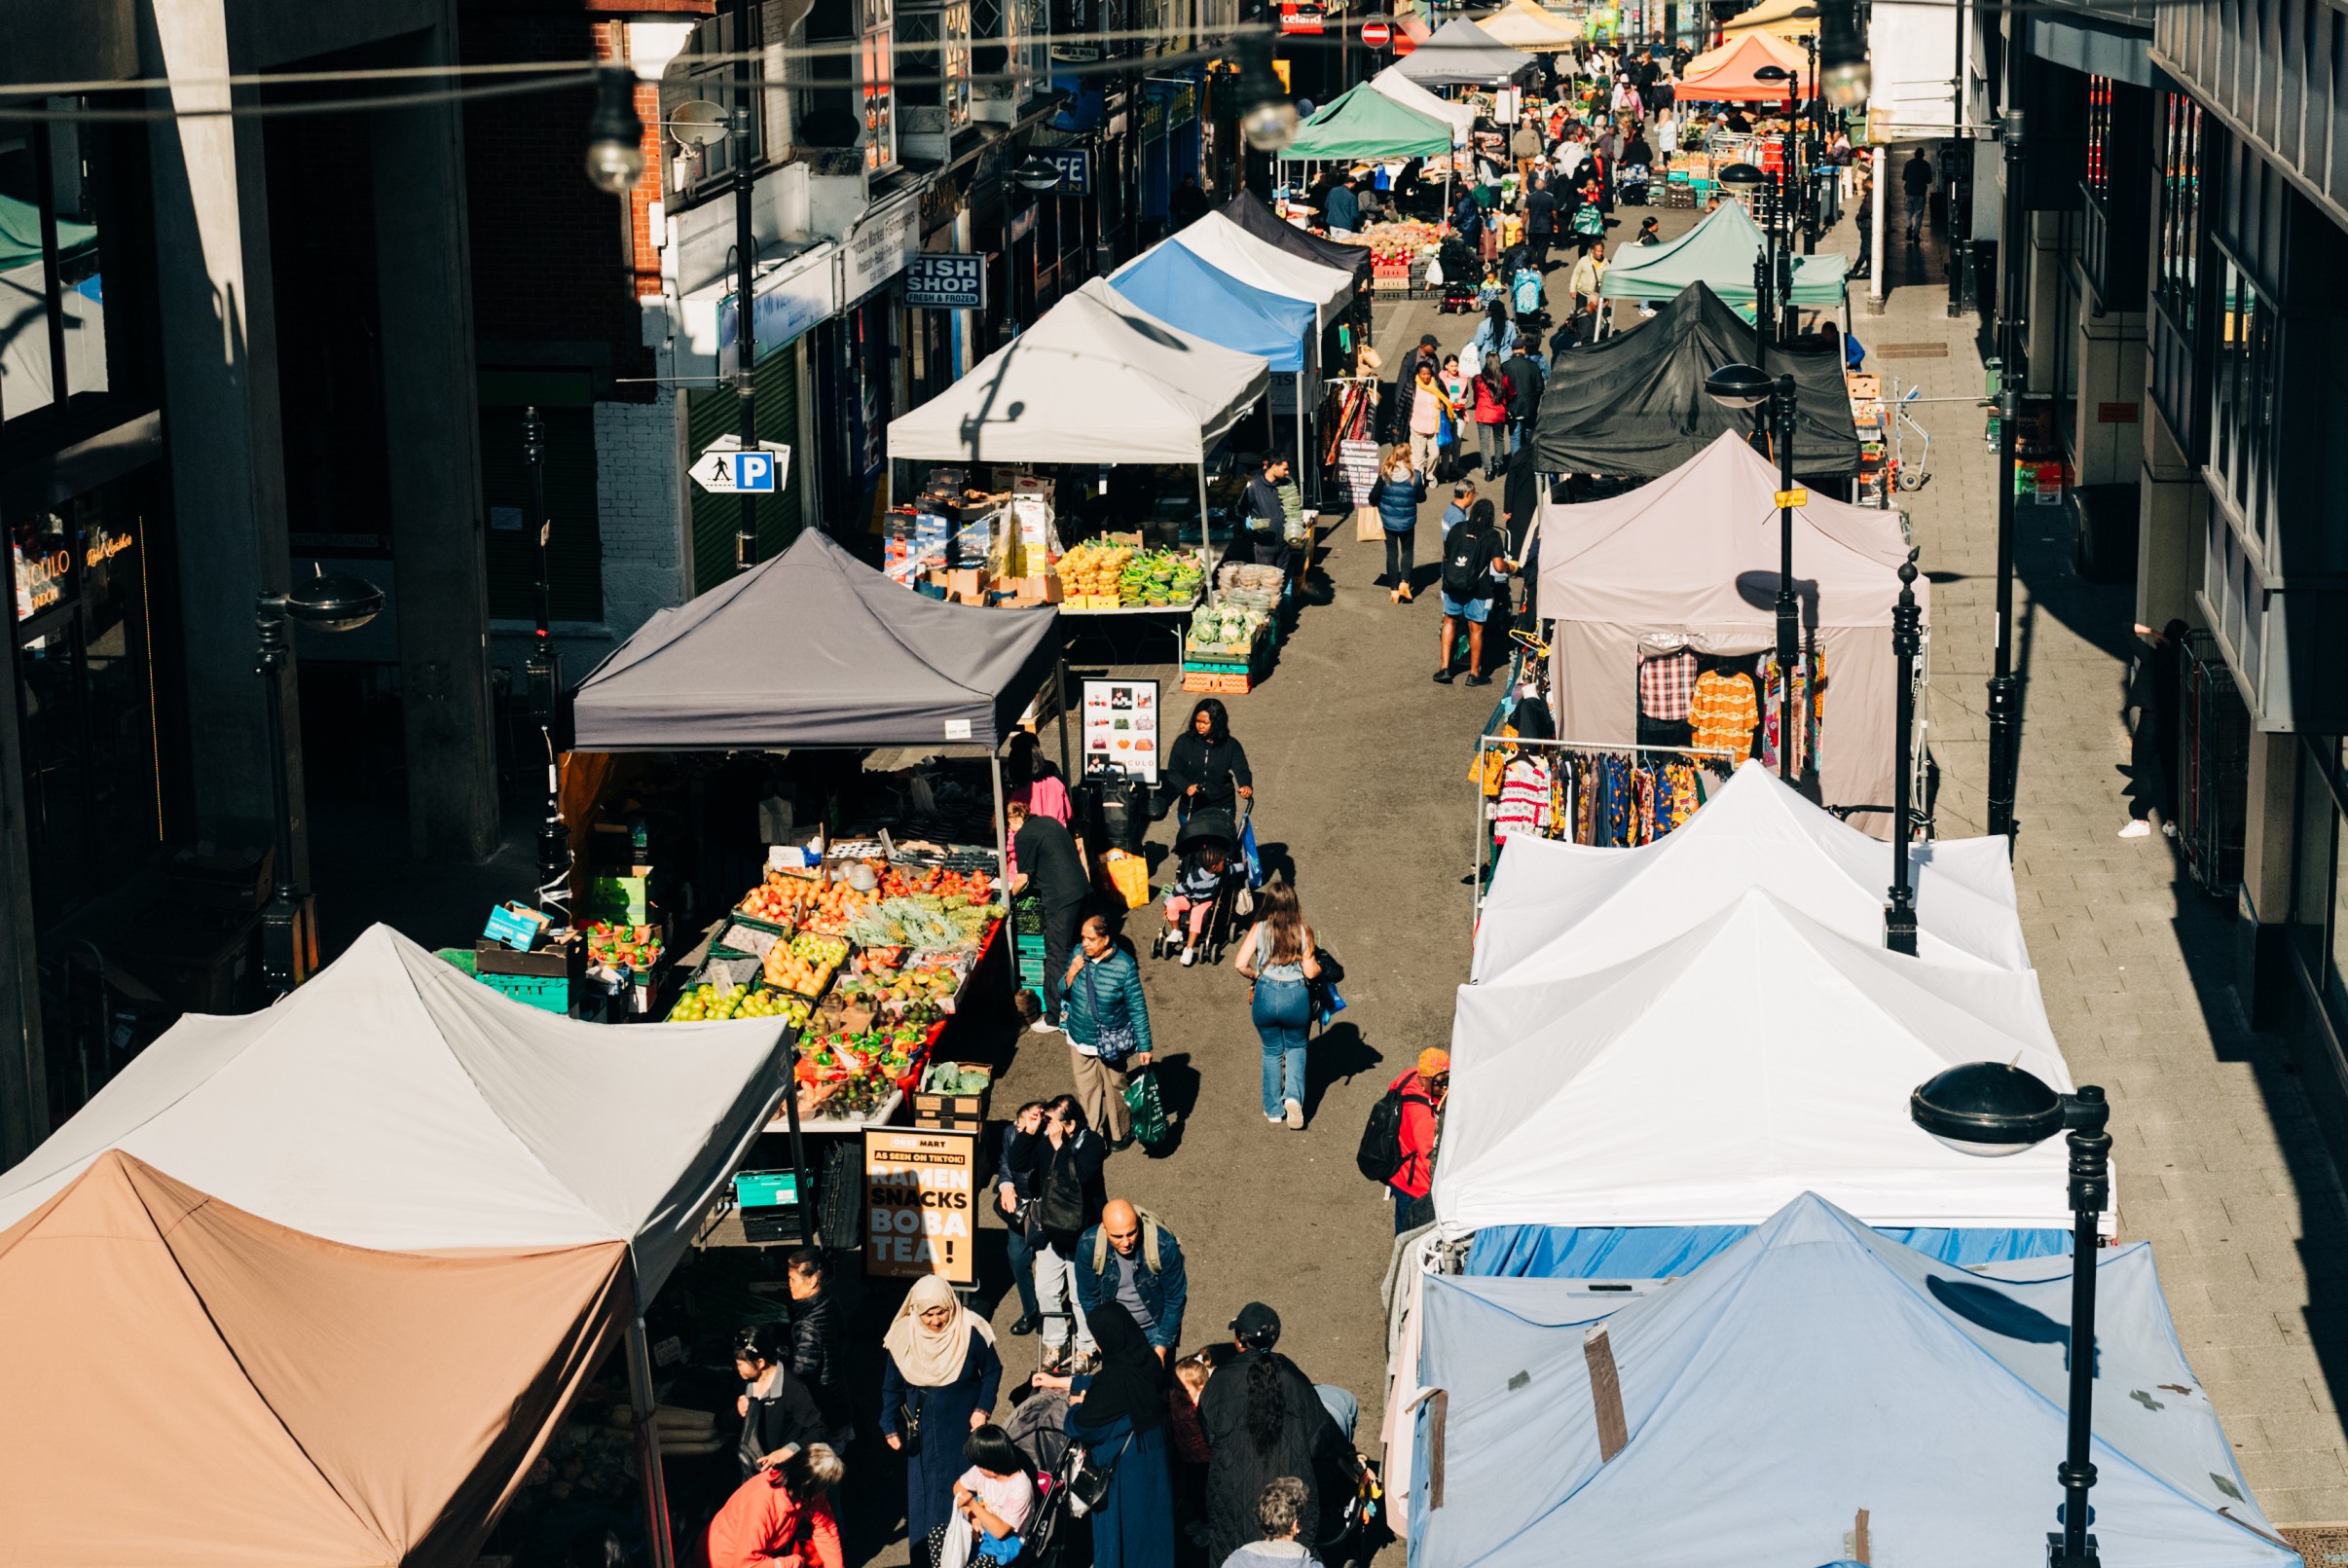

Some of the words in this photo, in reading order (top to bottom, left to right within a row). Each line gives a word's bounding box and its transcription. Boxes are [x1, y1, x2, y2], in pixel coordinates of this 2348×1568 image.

[1280, 13, 1322, 23] Iceland
[906, 259, 976, 276] FISH
[906, 276, 977, 291] SHOP
[908, 293, 935, 302] FRESH
[945, 294, 976, 303] FROZEN
[744, 456, 767, 487] P
[106, 532, 132, 558] Leather
[345, 536, 378, 546] YARD
[31, 587, 59, 609] ONDON
[919, 1140, 946, 1149] MART
[875, 1151, 889, 1160] AS
[890, 1152, 912, 1161] SEEN
[929, 1154, 964, 1164] TIKTOK!
[870, 1165, 969, 1189] RAMEN
[871, 1188, 968, 1209] SNACKS
[870, 1208, 968, 1237] BOBA
[871, 1236, 940, 1263] TEA
